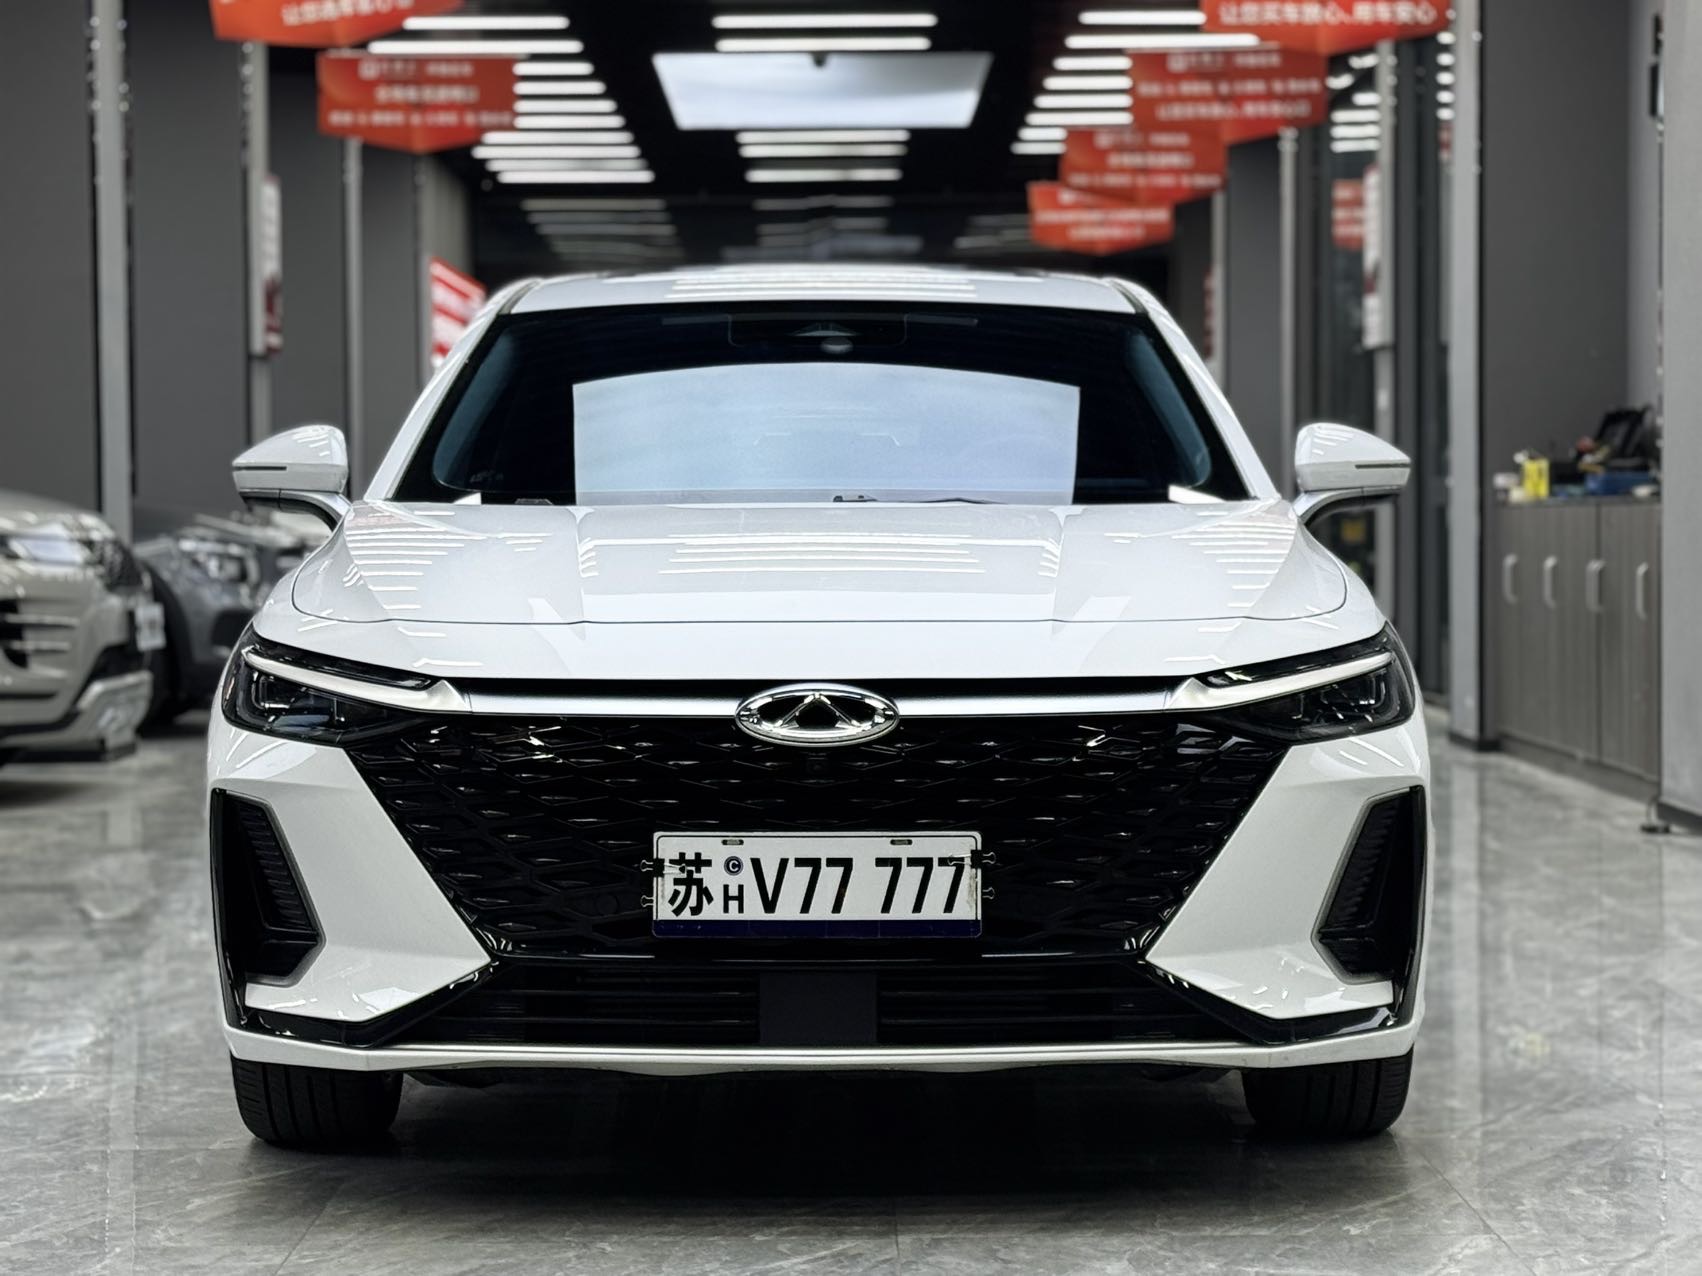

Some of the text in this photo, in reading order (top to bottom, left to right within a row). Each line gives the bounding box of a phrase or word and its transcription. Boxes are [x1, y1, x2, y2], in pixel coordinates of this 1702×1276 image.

[668, 852, 714, 917] 苏
[723, 884, 744, 914] H
[750, 857, 967, 914] V77 777
